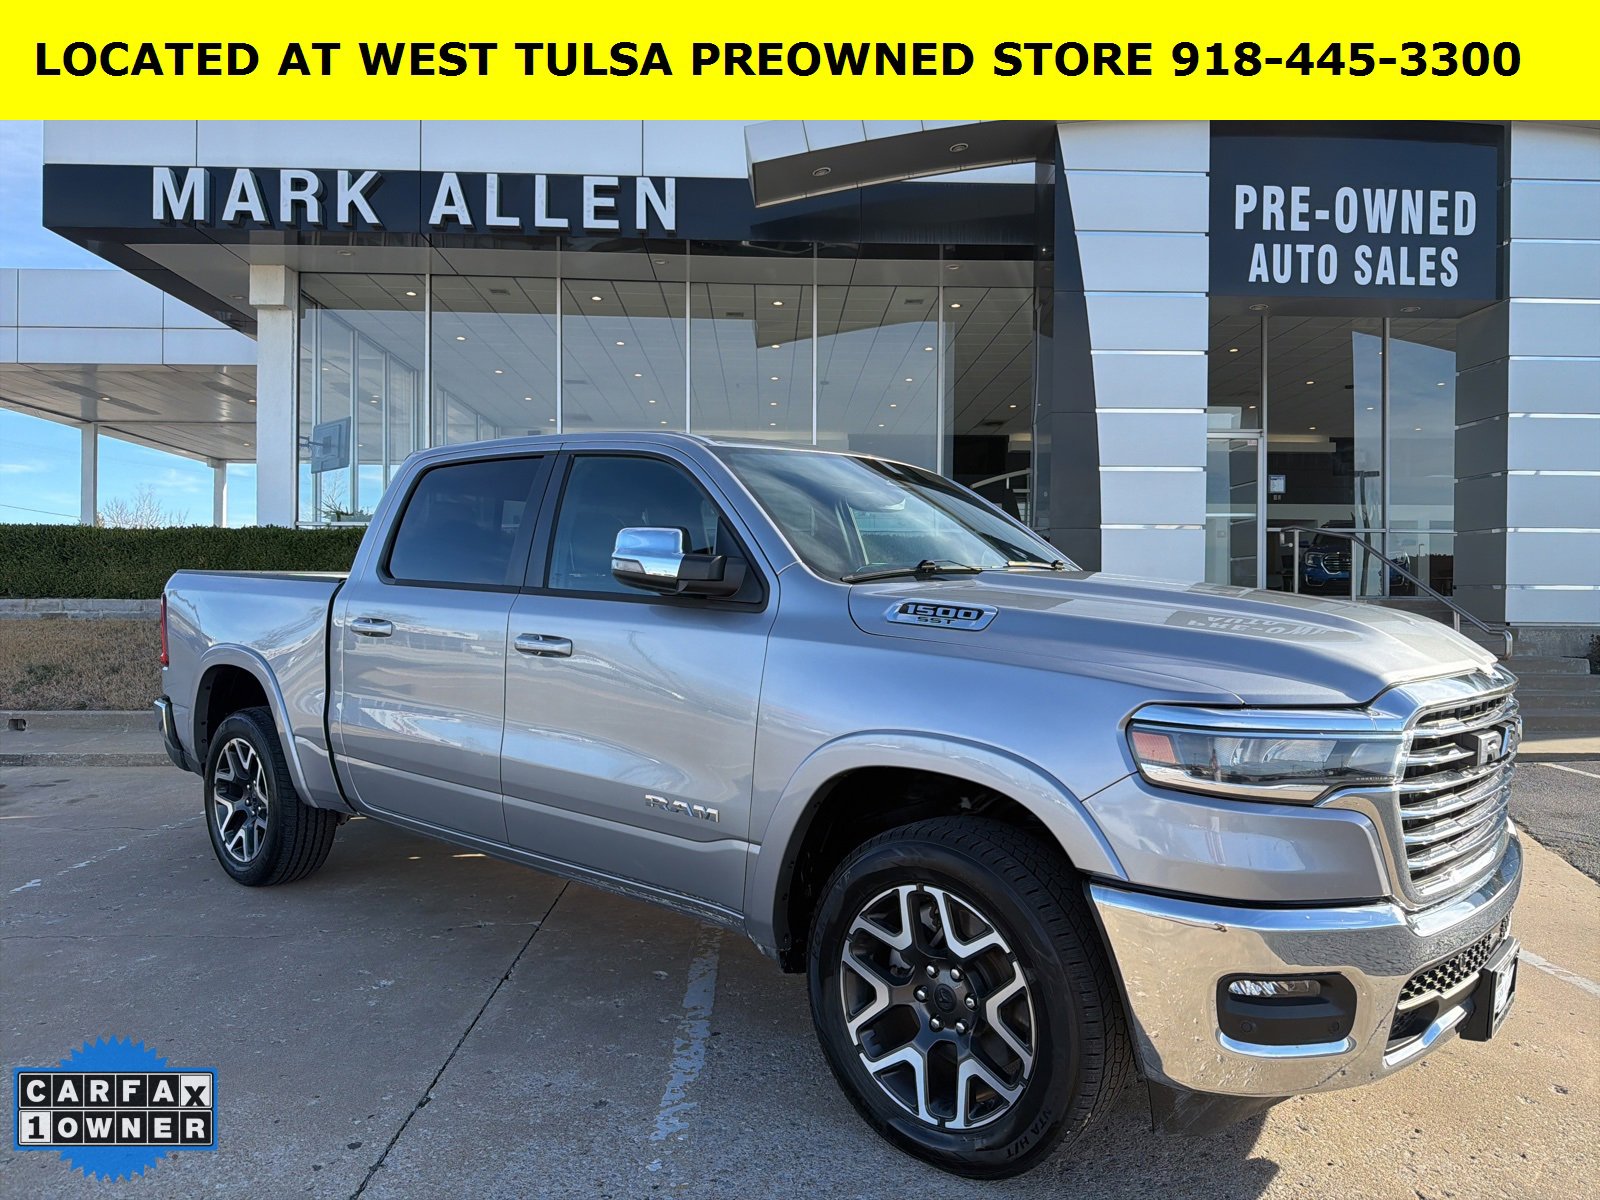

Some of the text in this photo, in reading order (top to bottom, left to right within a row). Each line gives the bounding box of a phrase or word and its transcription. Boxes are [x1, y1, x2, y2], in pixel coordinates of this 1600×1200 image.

[152, 167, 676, 231] MARK ALLEN
[1234, 184, 1477, 236] PRE-OWNED
[1248, 243, 1459, 288] AUTO SALES
[907, 604, 979, 620] 1500
[917, 616, 955, 625] SST
[644, 794, 720, 823] RAM
